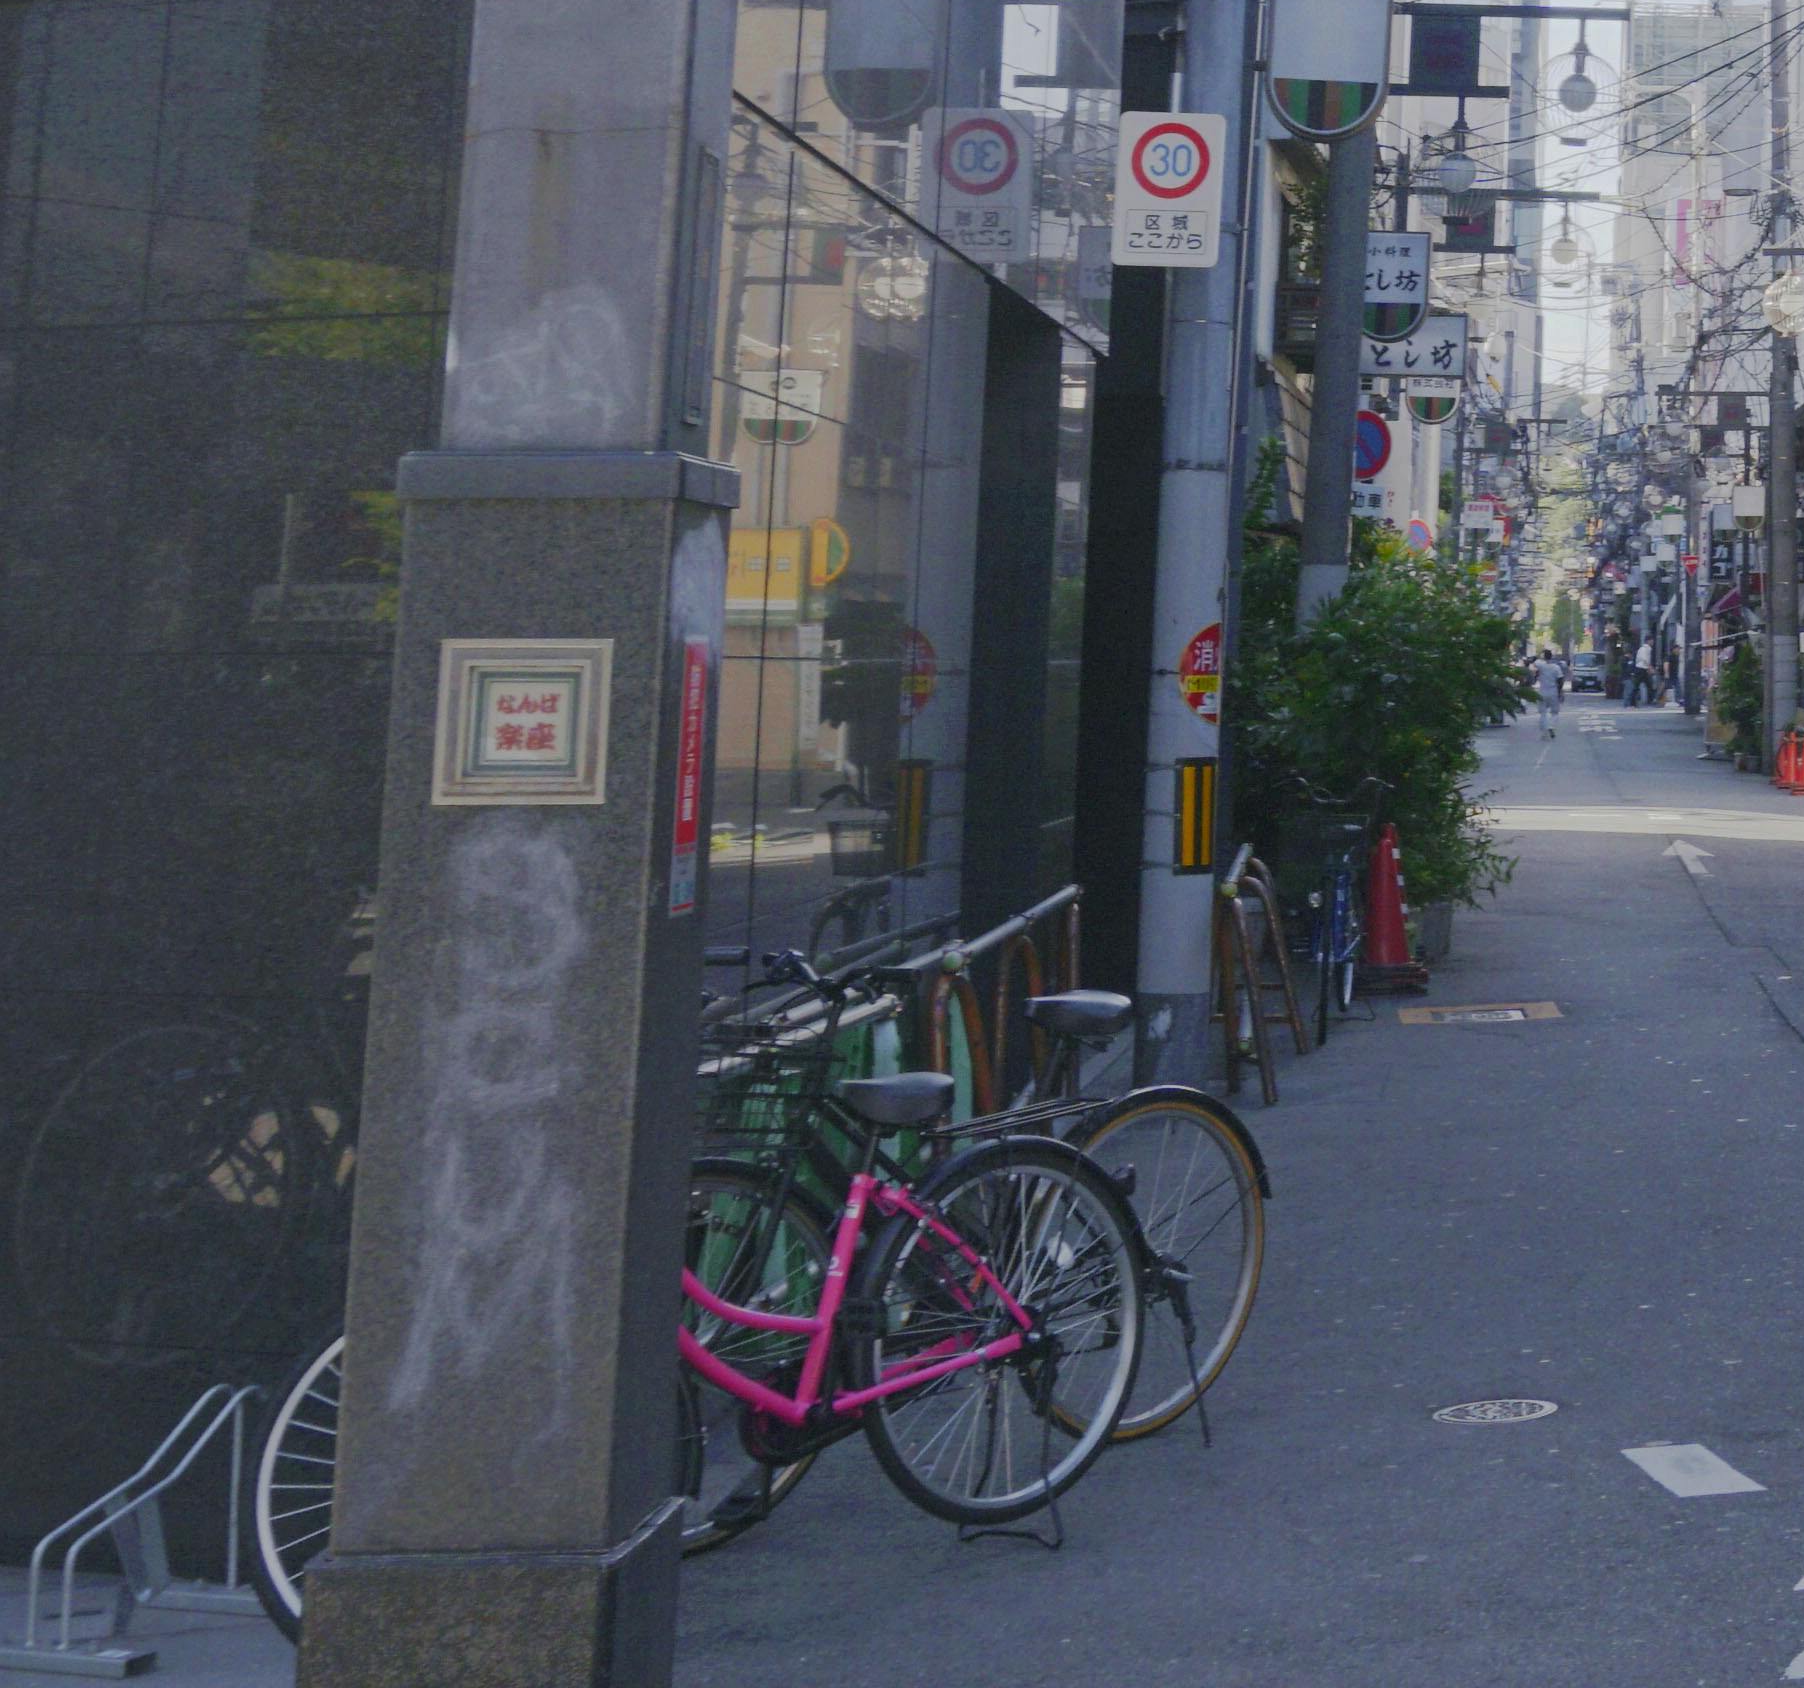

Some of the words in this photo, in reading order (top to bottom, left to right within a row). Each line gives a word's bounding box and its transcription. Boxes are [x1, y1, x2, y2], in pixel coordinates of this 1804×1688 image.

[1149, 143, 1192, 176] 30
[1145, 214, 1188, 231] 区域
[1128, 232, 1203, 250] ここから
[1370, 339, 1459, 370] とし坊
[495, 693, 562, 715] なんば
